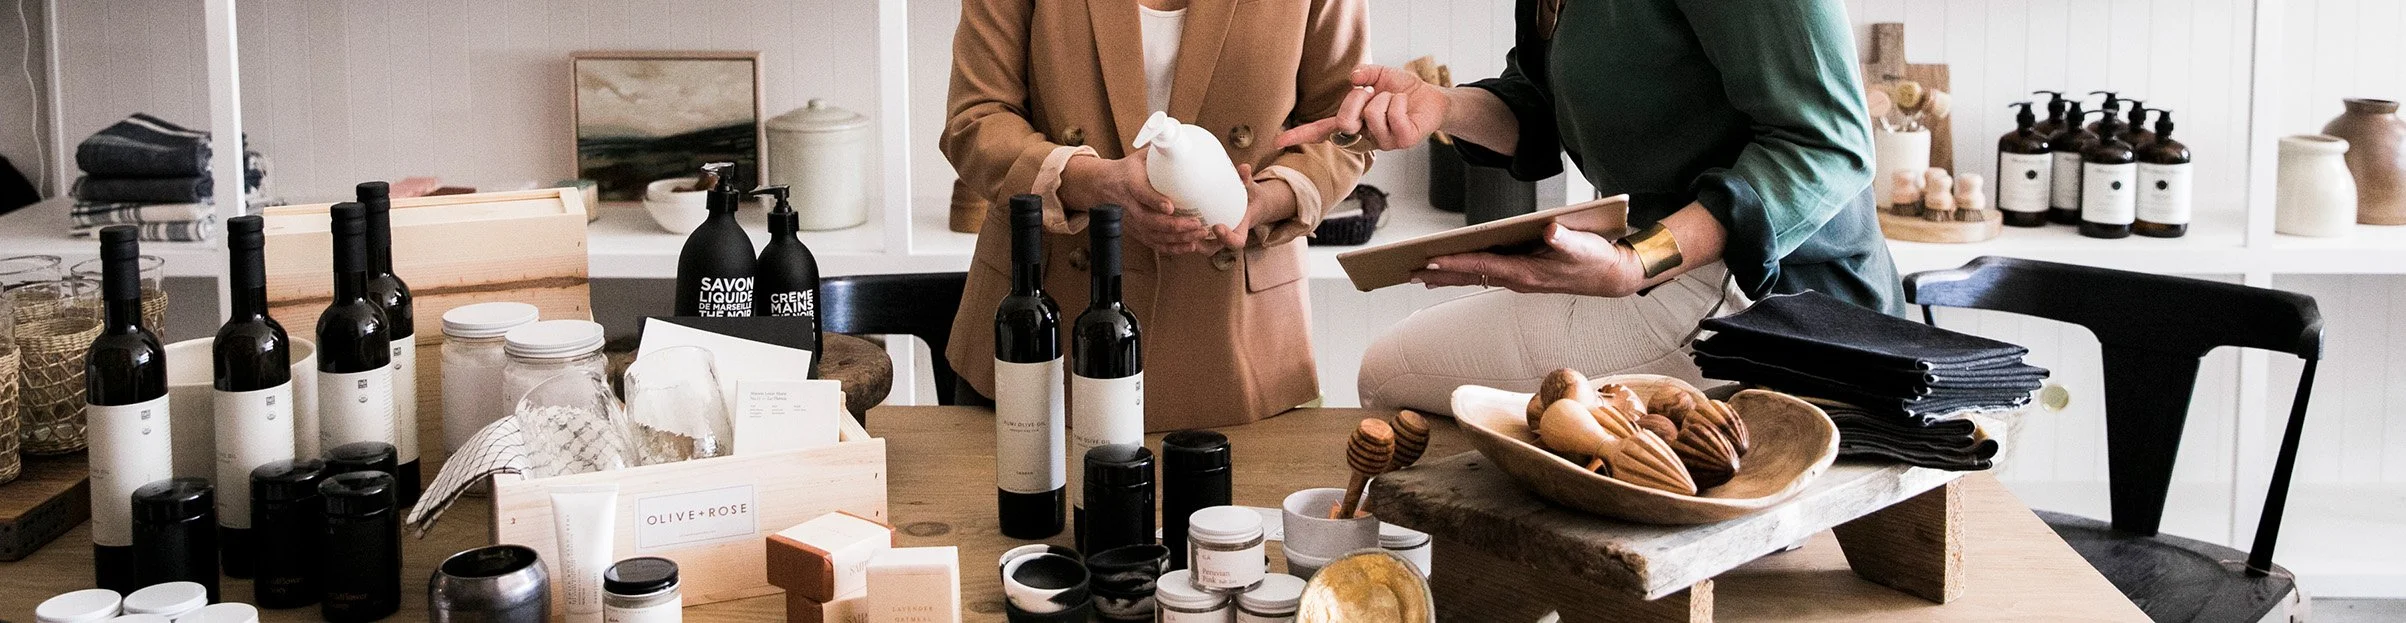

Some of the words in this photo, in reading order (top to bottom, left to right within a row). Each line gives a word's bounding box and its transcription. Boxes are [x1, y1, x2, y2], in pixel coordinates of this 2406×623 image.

[700, 276, 755, 292] SAVON
[699, 290, 754, 304] LIQUIDE
[770, 289, 814, 304] CREME
[698, 302, 712, 311] DE
[712, 301, 753, 311] MARSEILLE
[770, 300, 815, 314] MAINS
[699, 310, 724, 318] THE
[727, 309, 753, 318] NOIR
[1202, 567, 1231, 578] Peruvian
[1202, 574, 1217, 584] Pink
